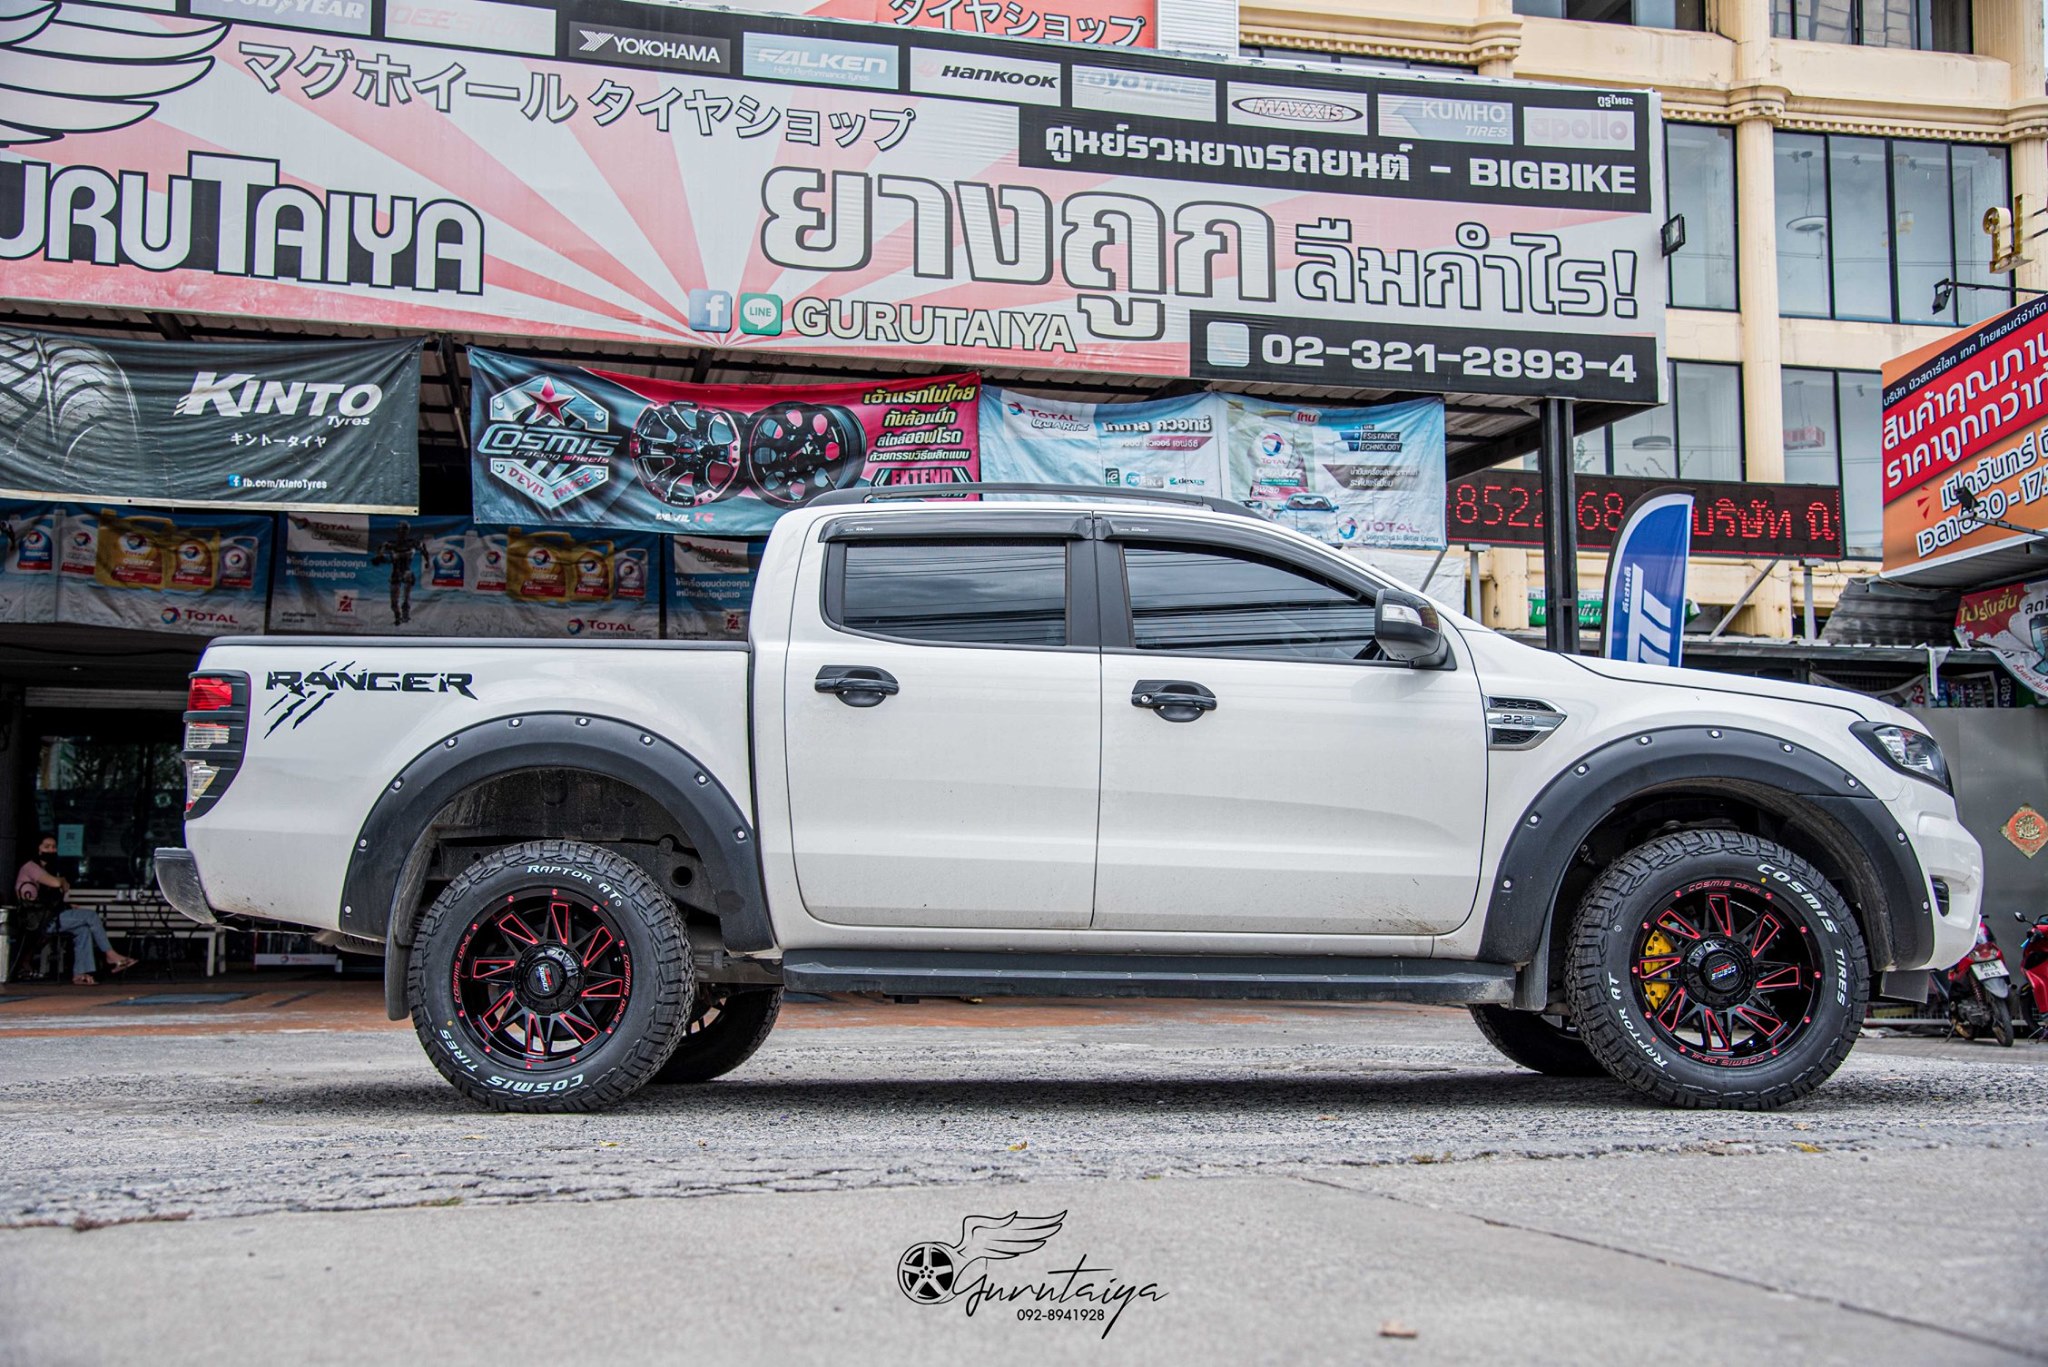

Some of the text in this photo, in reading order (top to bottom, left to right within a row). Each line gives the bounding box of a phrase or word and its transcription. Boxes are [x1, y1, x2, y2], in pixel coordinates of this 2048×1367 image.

[613, 36, 721, 64] YOKOHAMA
[755, 48, 888, 74] FALKEN
[238, 40, 916, 152] マグホイール タイヤショップ
[1254, 98, 1344, 121] MAXXIS
[1421, 101, 1507, 123] KUMHO
[1464, 125, 1509, 138] TIRES
[1530, 111, 1628, 141] apollo
[1045, 122, 1413, 182] ศูนย์รวมยางรถยนต์
[1469, 157, 1636, 194] BIGBIKE
[760, 165, 1639, 341] ยางถูก ลืมกำไร!
[749, 305, 773, 318] LINE
[792, 298, 1077, 353] GURUTAIYA
[1262, 334, 1638, 384] 02-321-2893-4
[173, 371, 383, 418] KINTO
[864, 384, 976, 404] เจ้าแรกในไทย
[1883, 385, 1907, 406] บริษัท
[327, 415, 371, 426] Tyres
[883, 406, 957, 427] กับล้อแม็ก
[1028, 409, 1080, 422] TOTAL
[1031, 418, 1090, 432] QUARTZ
[230, 432, 327, 448] キントータイヤ
[477, 424, 622, 457] COSMIS
[876, 428, 963, 447] สไตล์ออฟโรด
[512, 450, 609, 464] racing wheels
[508, 466, 592, 501] DEVIL IMAGE
[891, 468, 953, 486] EXTEND
[313, 522, 352, 531] TOTAL
[1363, 520, 1421, 534] TOTAL
[185, 609, 239, 624] TOTAL
[1960, 589, 2018, 623] โปรโมชั่น
[587, 618, 636, 632] TOTAL
[265, 669, 479, 701] RANGER
[526, 864, 622, 901] RAPTOR AT
[1688, 879, 1731, 892] COSMIS
[1757, 863, 1846, 1008] COSMIS TIRES
[1608, 971, 1669, 1068] RAPTOR AT
[439, 1028, 584, 1094] COSMIS TIRES
